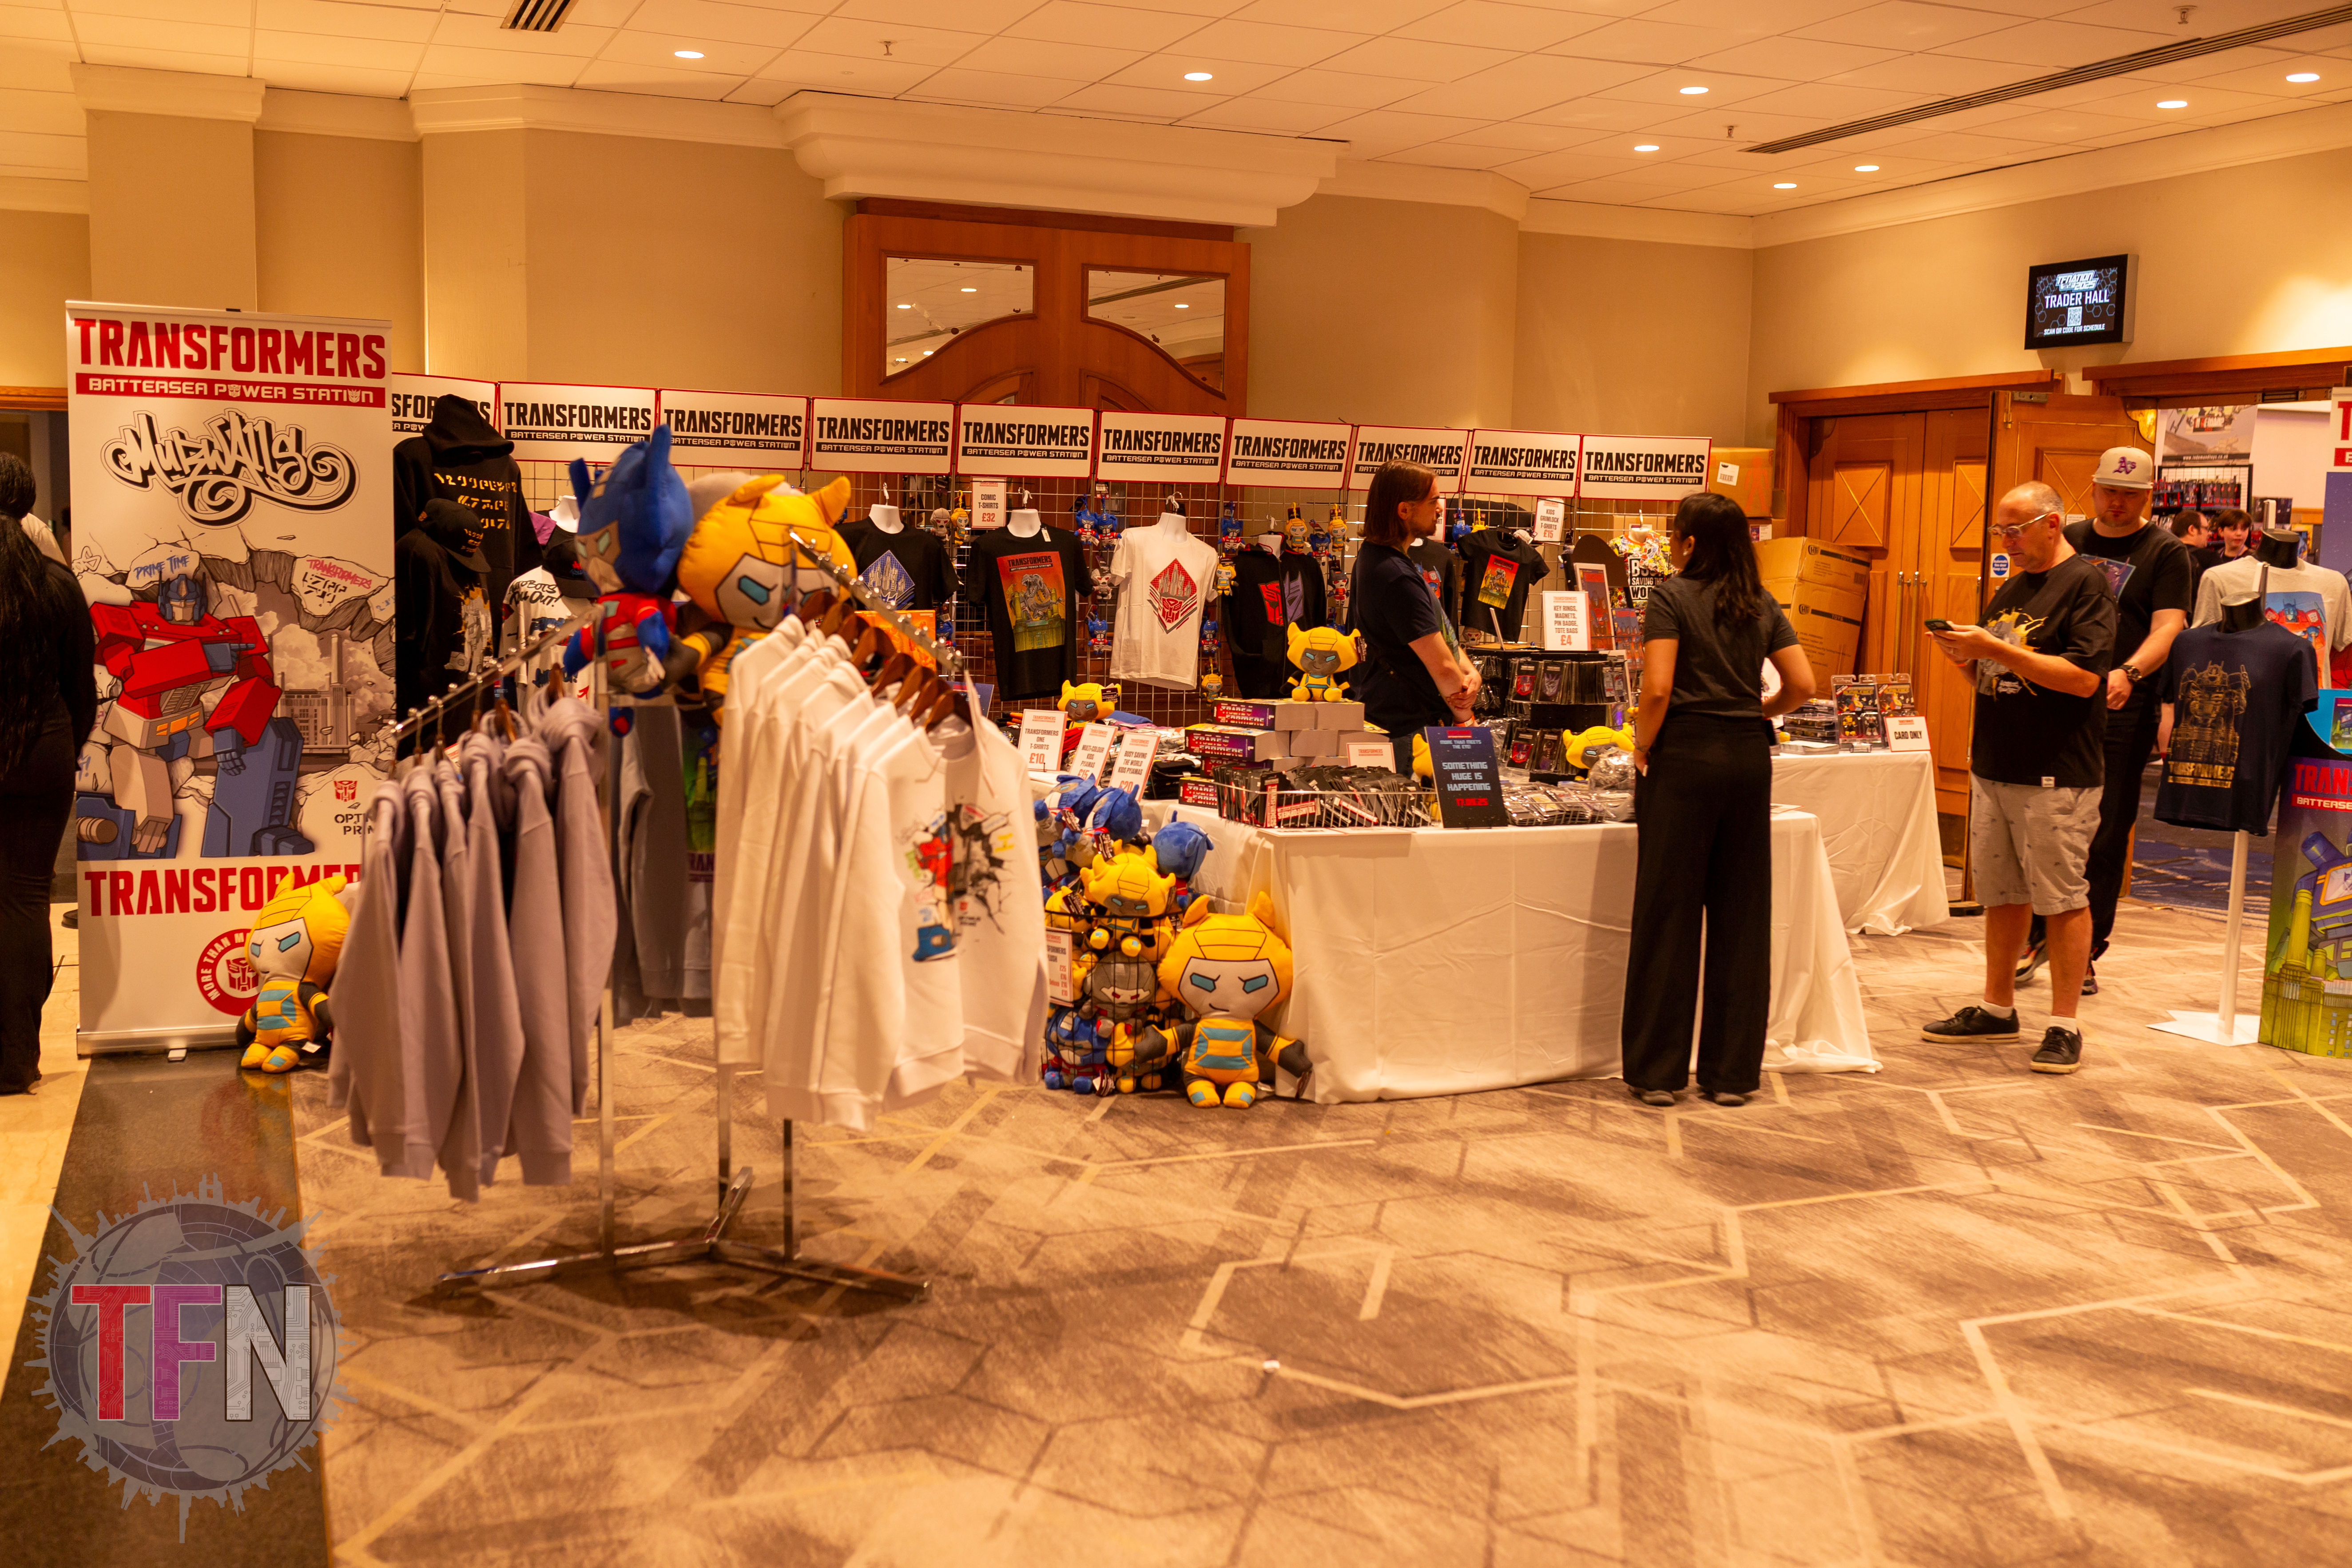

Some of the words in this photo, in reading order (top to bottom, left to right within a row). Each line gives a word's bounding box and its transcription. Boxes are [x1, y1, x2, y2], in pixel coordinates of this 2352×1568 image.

[2076, 280, 2097, 291] 2025
[2045, 293, 2082, 309] TRADER
[2085, 289, 2110, 304] HALL
[2083, 323, 2105, 332] SCHEDULE
[75, 318, 385, 379] TRANSFORMERS
[89, 377, 208, 396] BATTERSEA
[505, 402, 651, 431] TRANSFORMERS
[664, 409, 802, 437] TRANSFORMERS
[817, 417, 949, 442] TRANSFORMERS
[963, 422, 1089, 447] TRANSFORMERS
[1104, 429, 1221, 453] TRANSFORMERS
[1234, 435, 1347, 460] TRANSFORMERS
[1359, 442, 1463, 465] TRANSFORMERS
[1474, 445, 1576, 469] TRANSFORMERS
[1586, 452, 1704, 473] TRANSFORMERS
[982, 513, 995, 522] £32
[1543, 529, 1553, 538] £15
[134, 561, 166, 580] PRIME
[167, 555, 190, 574] TIME
[1008, 556, 1053, 567] TRANSFORMERS
[306, 560, 372, 589] TRANSFORMERS
[1561, 635, 1572, 645] £4
[1029, 753, 1045, 764] £10
[1081, 745, 1104, 753] MULTI-COLOUR
[1077, 769, 1089, 780] £15
[2294, 763, 2352, 795] TRAN
[1119, 780, 1133, 794] £20
[203, 937, 231, 964] THAN
[201, 968, 221, 1000] MORE
